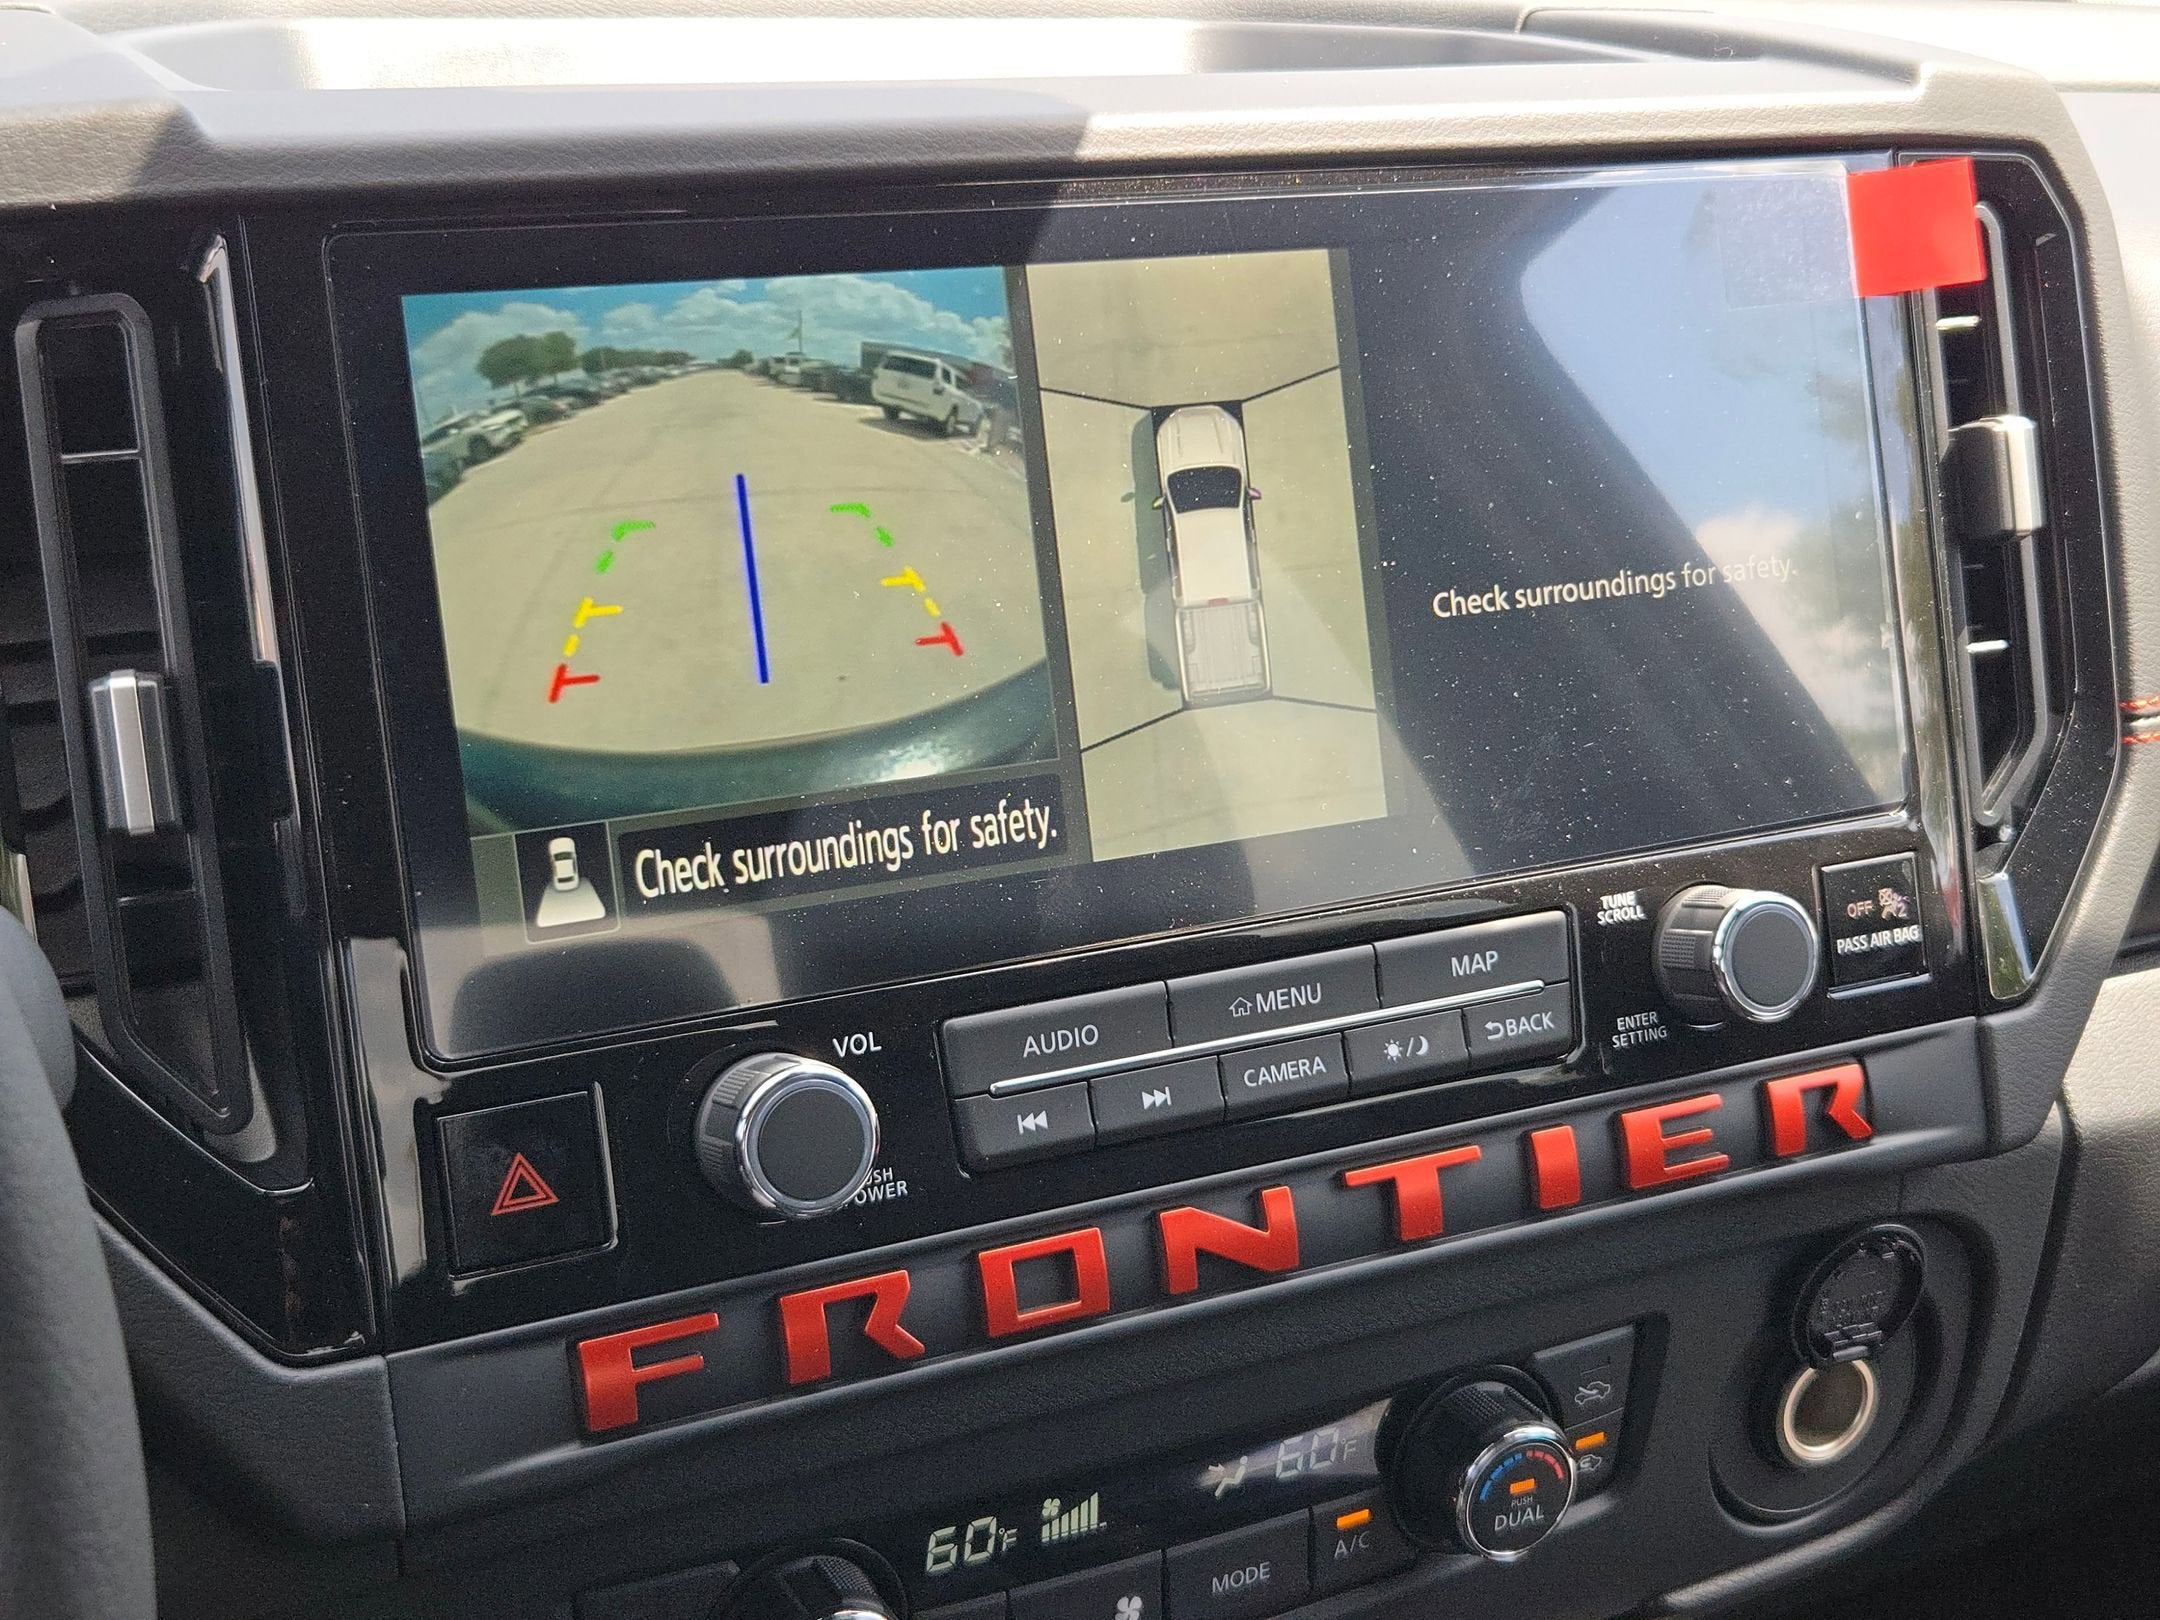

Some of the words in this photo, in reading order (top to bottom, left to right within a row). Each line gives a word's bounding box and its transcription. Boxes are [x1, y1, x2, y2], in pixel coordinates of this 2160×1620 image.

[1432, 584, 1511, 618] Check
[1514, 569, 1677, 609] surroundings
[1681, 562, 1717, 587] for
[1722, 555, 1798, 583] safety.
[635, 842, 725, 899] Check
[733, 820, 914, 885] surroundings
[921, 810, 962, 856] for
[972, 799, 1058, 849] safety.
[1599, 890, 1636, 911] TUNE
[1846, 899, 1873, 918] OFF
[1597, 904, 1646, 926] SCROLL
[1836, 934, 1868, 954] PASS
[1870, 930, 1893, 949] AIR
[1892, 924, 1921, 945] BAG
[1450, 950, 1500, 978] MAP
[1255, 982, 1323, 1015] MENU
[1505, 1010, 1556, 1037] BACK
[1616, 1011, 1659, 1032] ENTER
[832, 1031, 883, 1058] VOL
[1022, 1023, 1100, 1058] AUDIO
[1611, 1025, 1668, 1050] SETTING
[1243, 1056, 1327, 1089] CAMERA
[867, 1166, 894, 1184] SH
[854, 1180, 909, 1204] OWER
[577, 1062, 1874, 1434] FRONTIER
[1511, 1495, 1534, 1508] PUSH
[1494, 1504, 1545, 1532] DUAL
[1333, 1531, 1371, 1560] A/C
[1211, 1562, 1271, 1594] MODE
